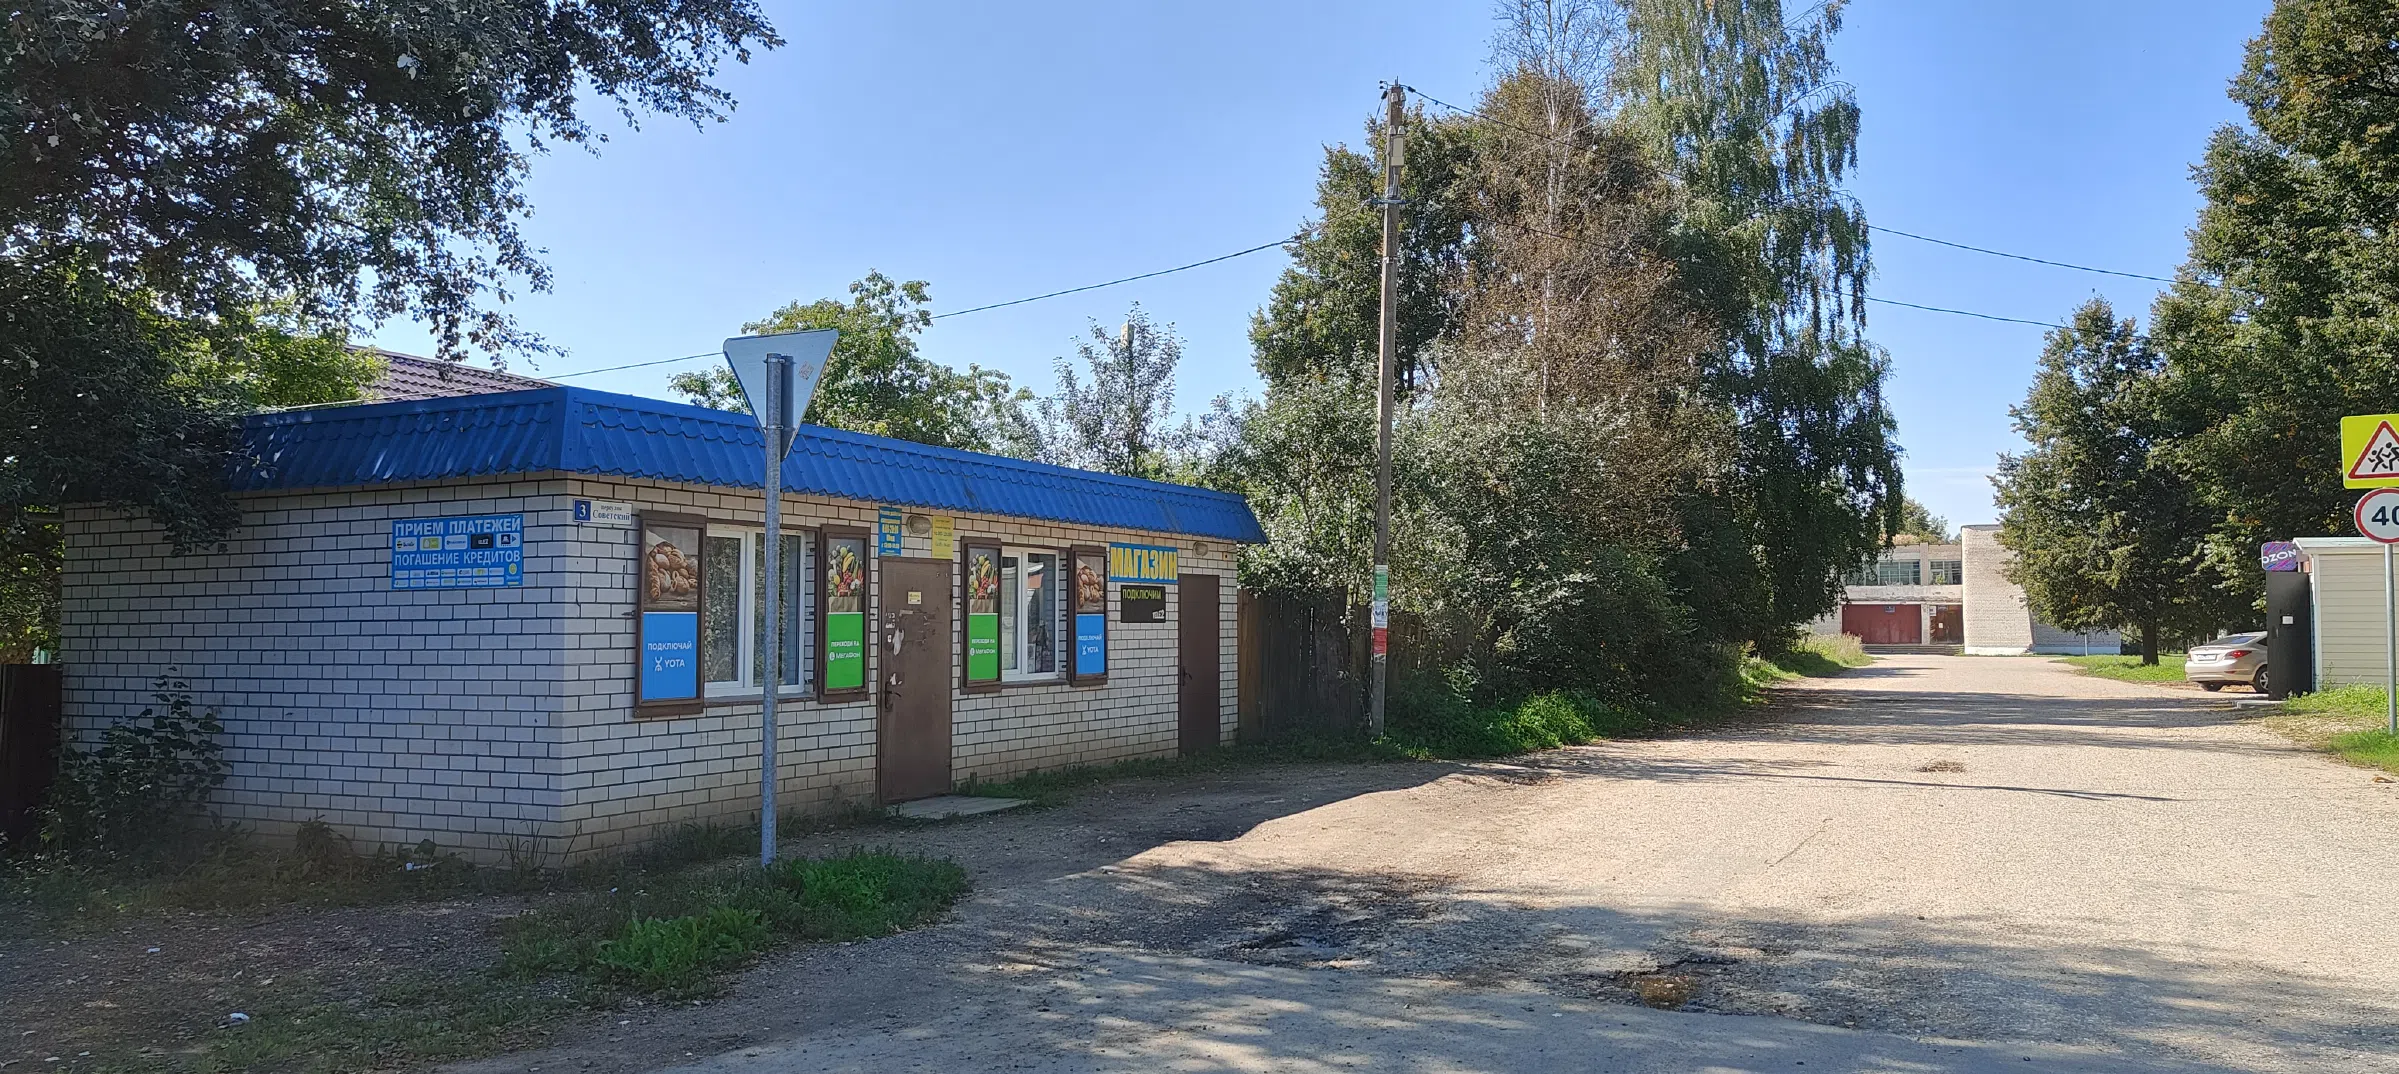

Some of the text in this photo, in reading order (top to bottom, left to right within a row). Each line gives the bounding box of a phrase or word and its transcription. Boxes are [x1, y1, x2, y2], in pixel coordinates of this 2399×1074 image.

[579, 504, 587, 517] 3
[593, 510, 630, 521] Советский
[395, 515, 520, 537] ПРИЕМ ПЛАТЕЖЕЙ
[395, 550, 520, 566] ПОГАШЕНИЕ КРЕДИТОВ
[2262, 549, 2296, 564] OZON
[1110, 547, 1178, 580] МАГАЗИН
[1122, 588, 1162, 601] ПОДКЛЮЧИМ
[647, 641, 692, 651] ПОДКЛЮЧАЙ
[664, 659, 685, 668] YOTA
